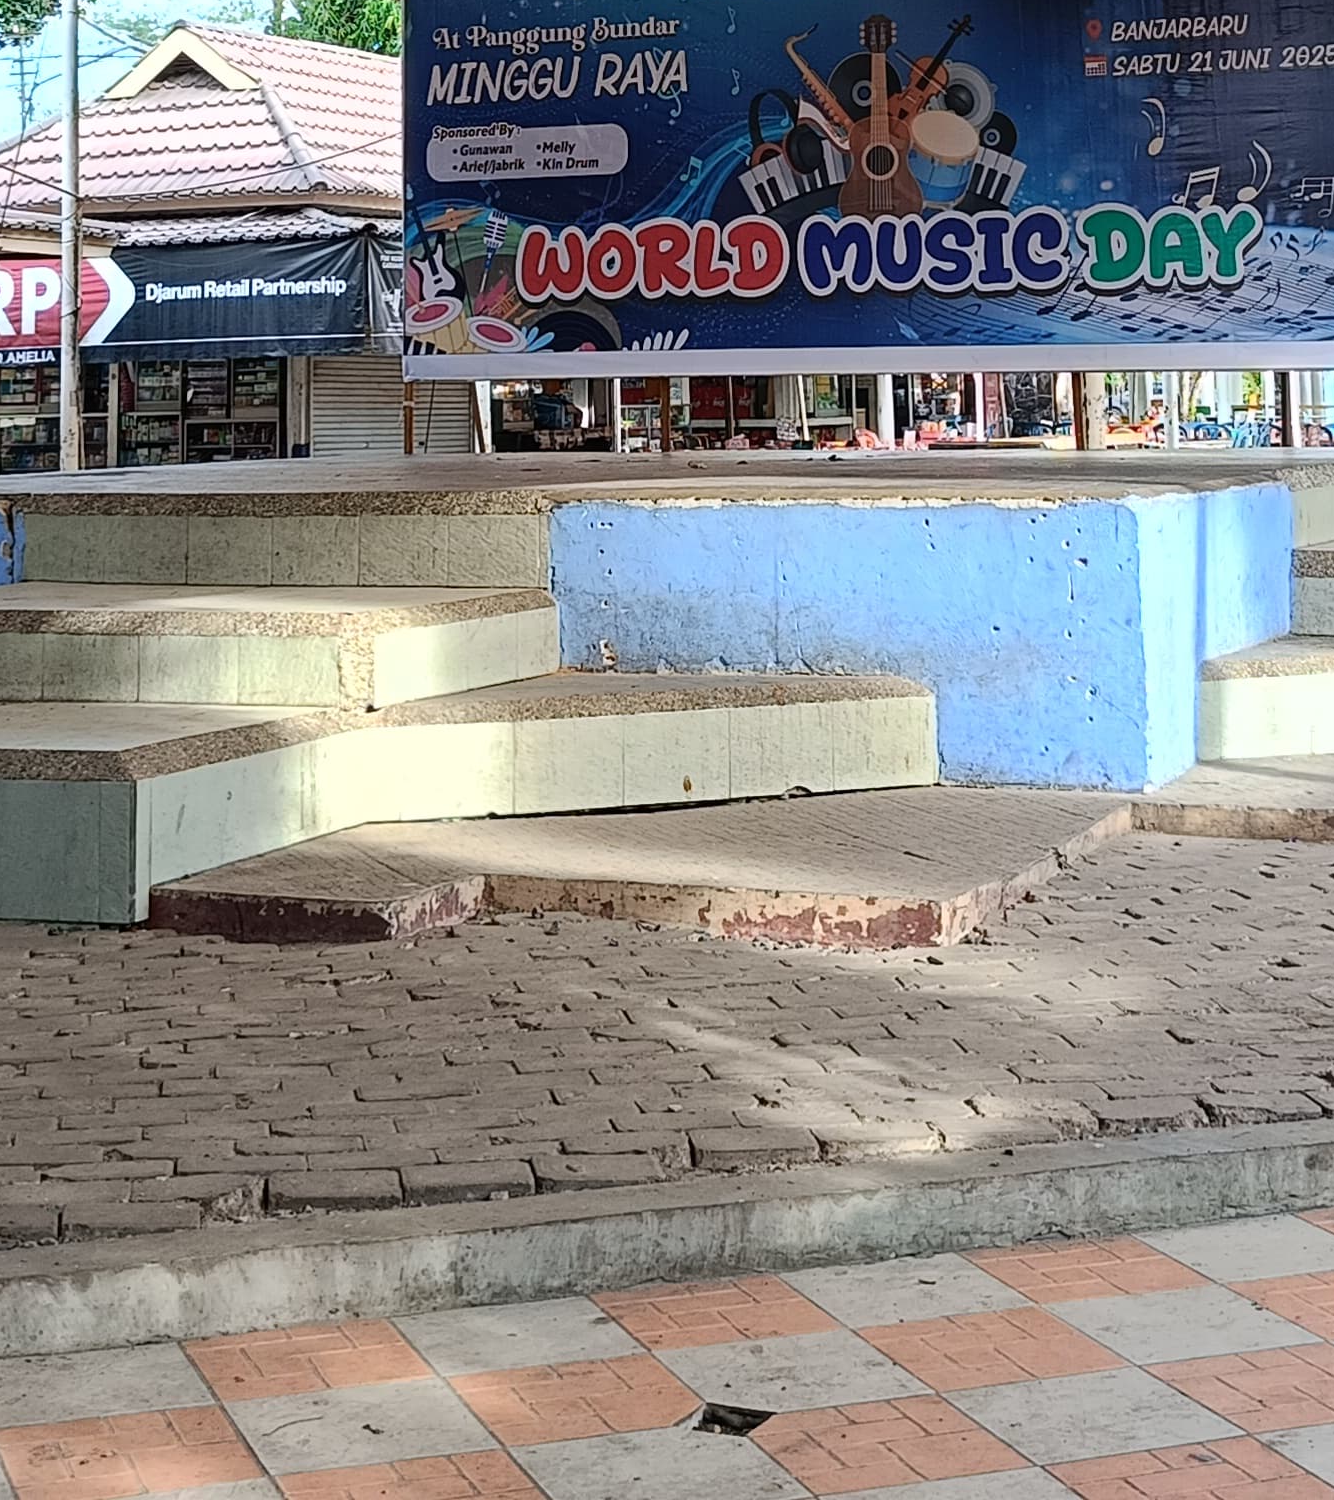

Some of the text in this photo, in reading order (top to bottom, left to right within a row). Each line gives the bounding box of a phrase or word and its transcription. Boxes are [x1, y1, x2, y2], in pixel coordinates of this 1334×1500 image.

[432, 16, 680, 55] At Panggung Bundar
[1111, 13, 1249, 42] BANJARBARU
[1112, 51, 1180, 77] SABTU
[1188, 50, 1214, 73] 21
[1218, 48, 1272, 72] JUNI
[427, 50, 688, 106] MINGGU RAYA
[433, 124, 495, 140] Sponsored
[460, 141, 576, 157] Gunawan Melly
[566, 157, 599, 170] Drum
[516, 204, 1264, 302] WORLD MUSIC DAY
[145, 276, 347, 302] Djarum Retail Partnership
[6, 350, 56, 364] AMELIA
